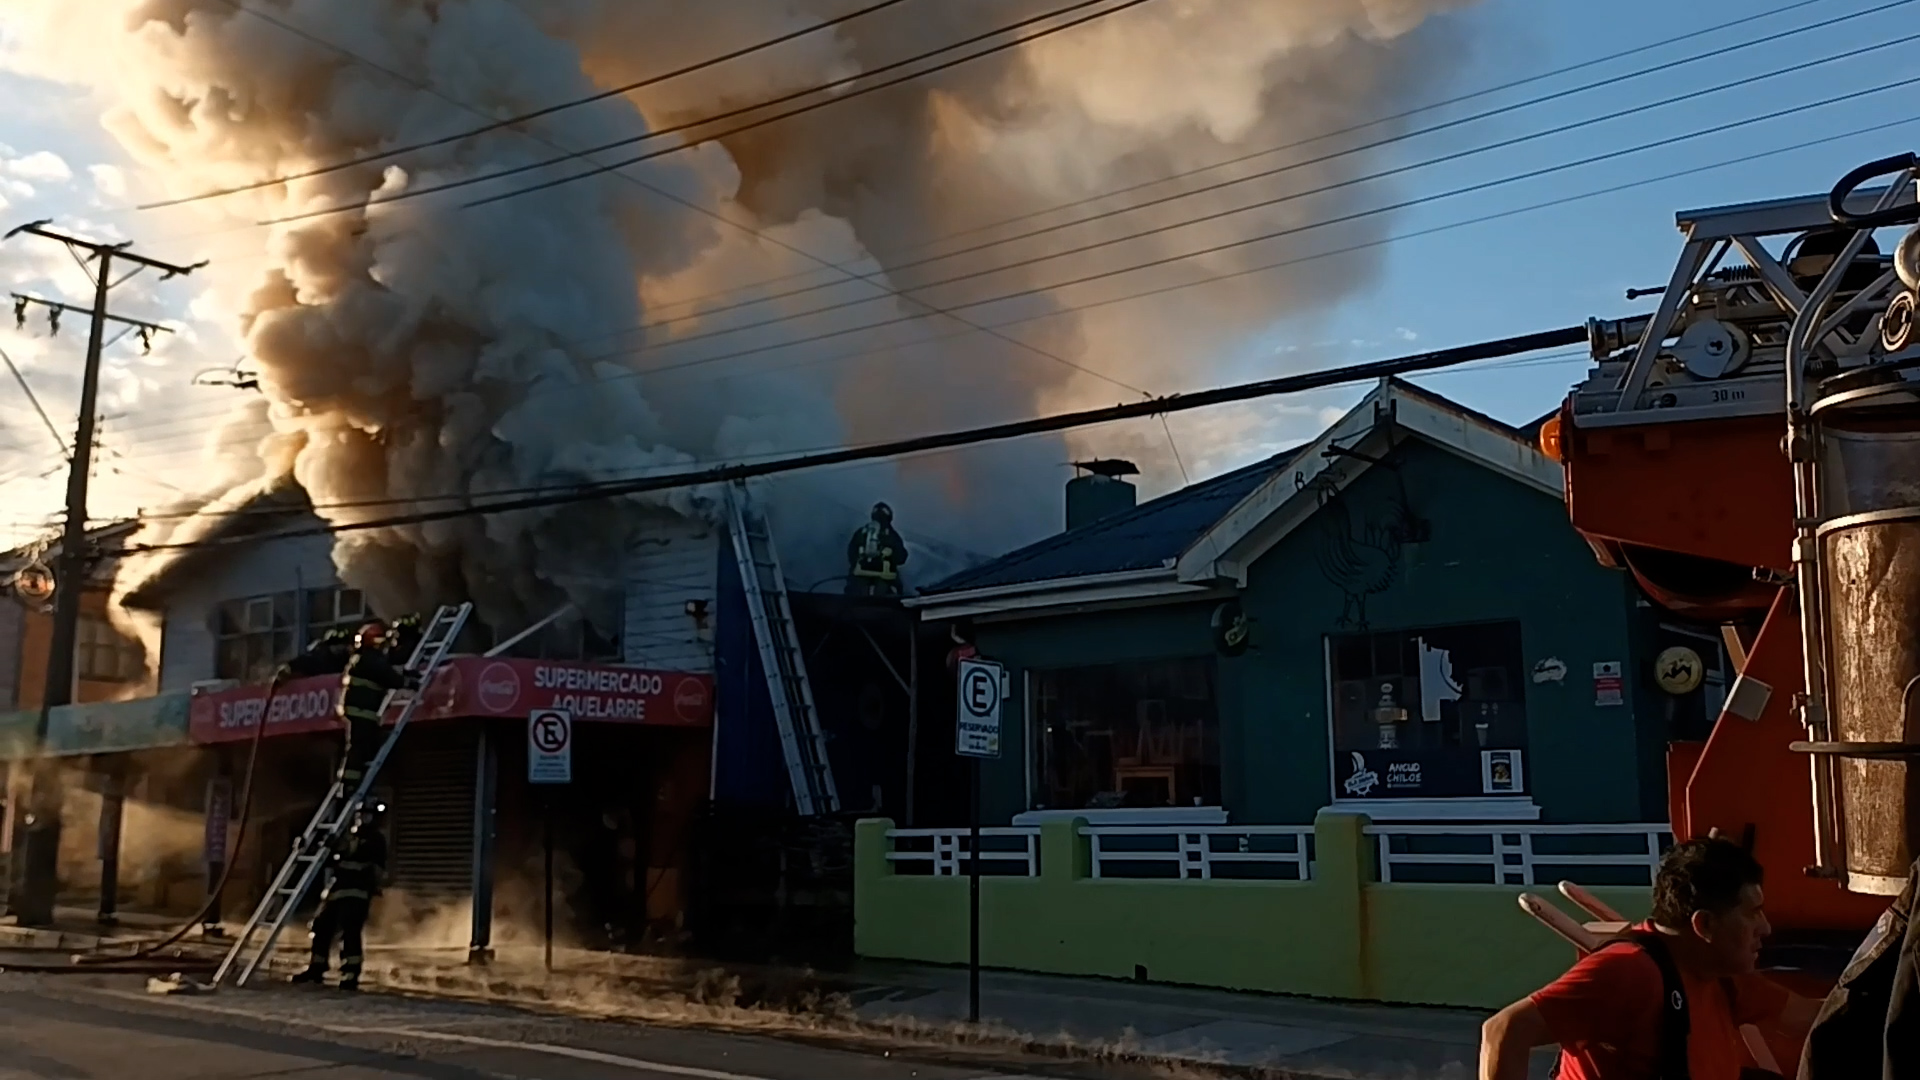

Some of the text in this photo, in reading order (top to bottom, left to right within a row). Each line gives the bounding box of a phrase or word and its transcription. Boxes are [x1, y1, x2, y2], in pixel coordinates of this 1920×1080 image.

[1712, 389, 1728, 402] 30
[534, 666, 663, 695] SUPERMERCADO
[973, 675, 987, 708] E
[544, 721, 558, 744] E
[959, 722, 999, 734] RESERVADO
[1388, 762, 1421, 773] ANCUD
